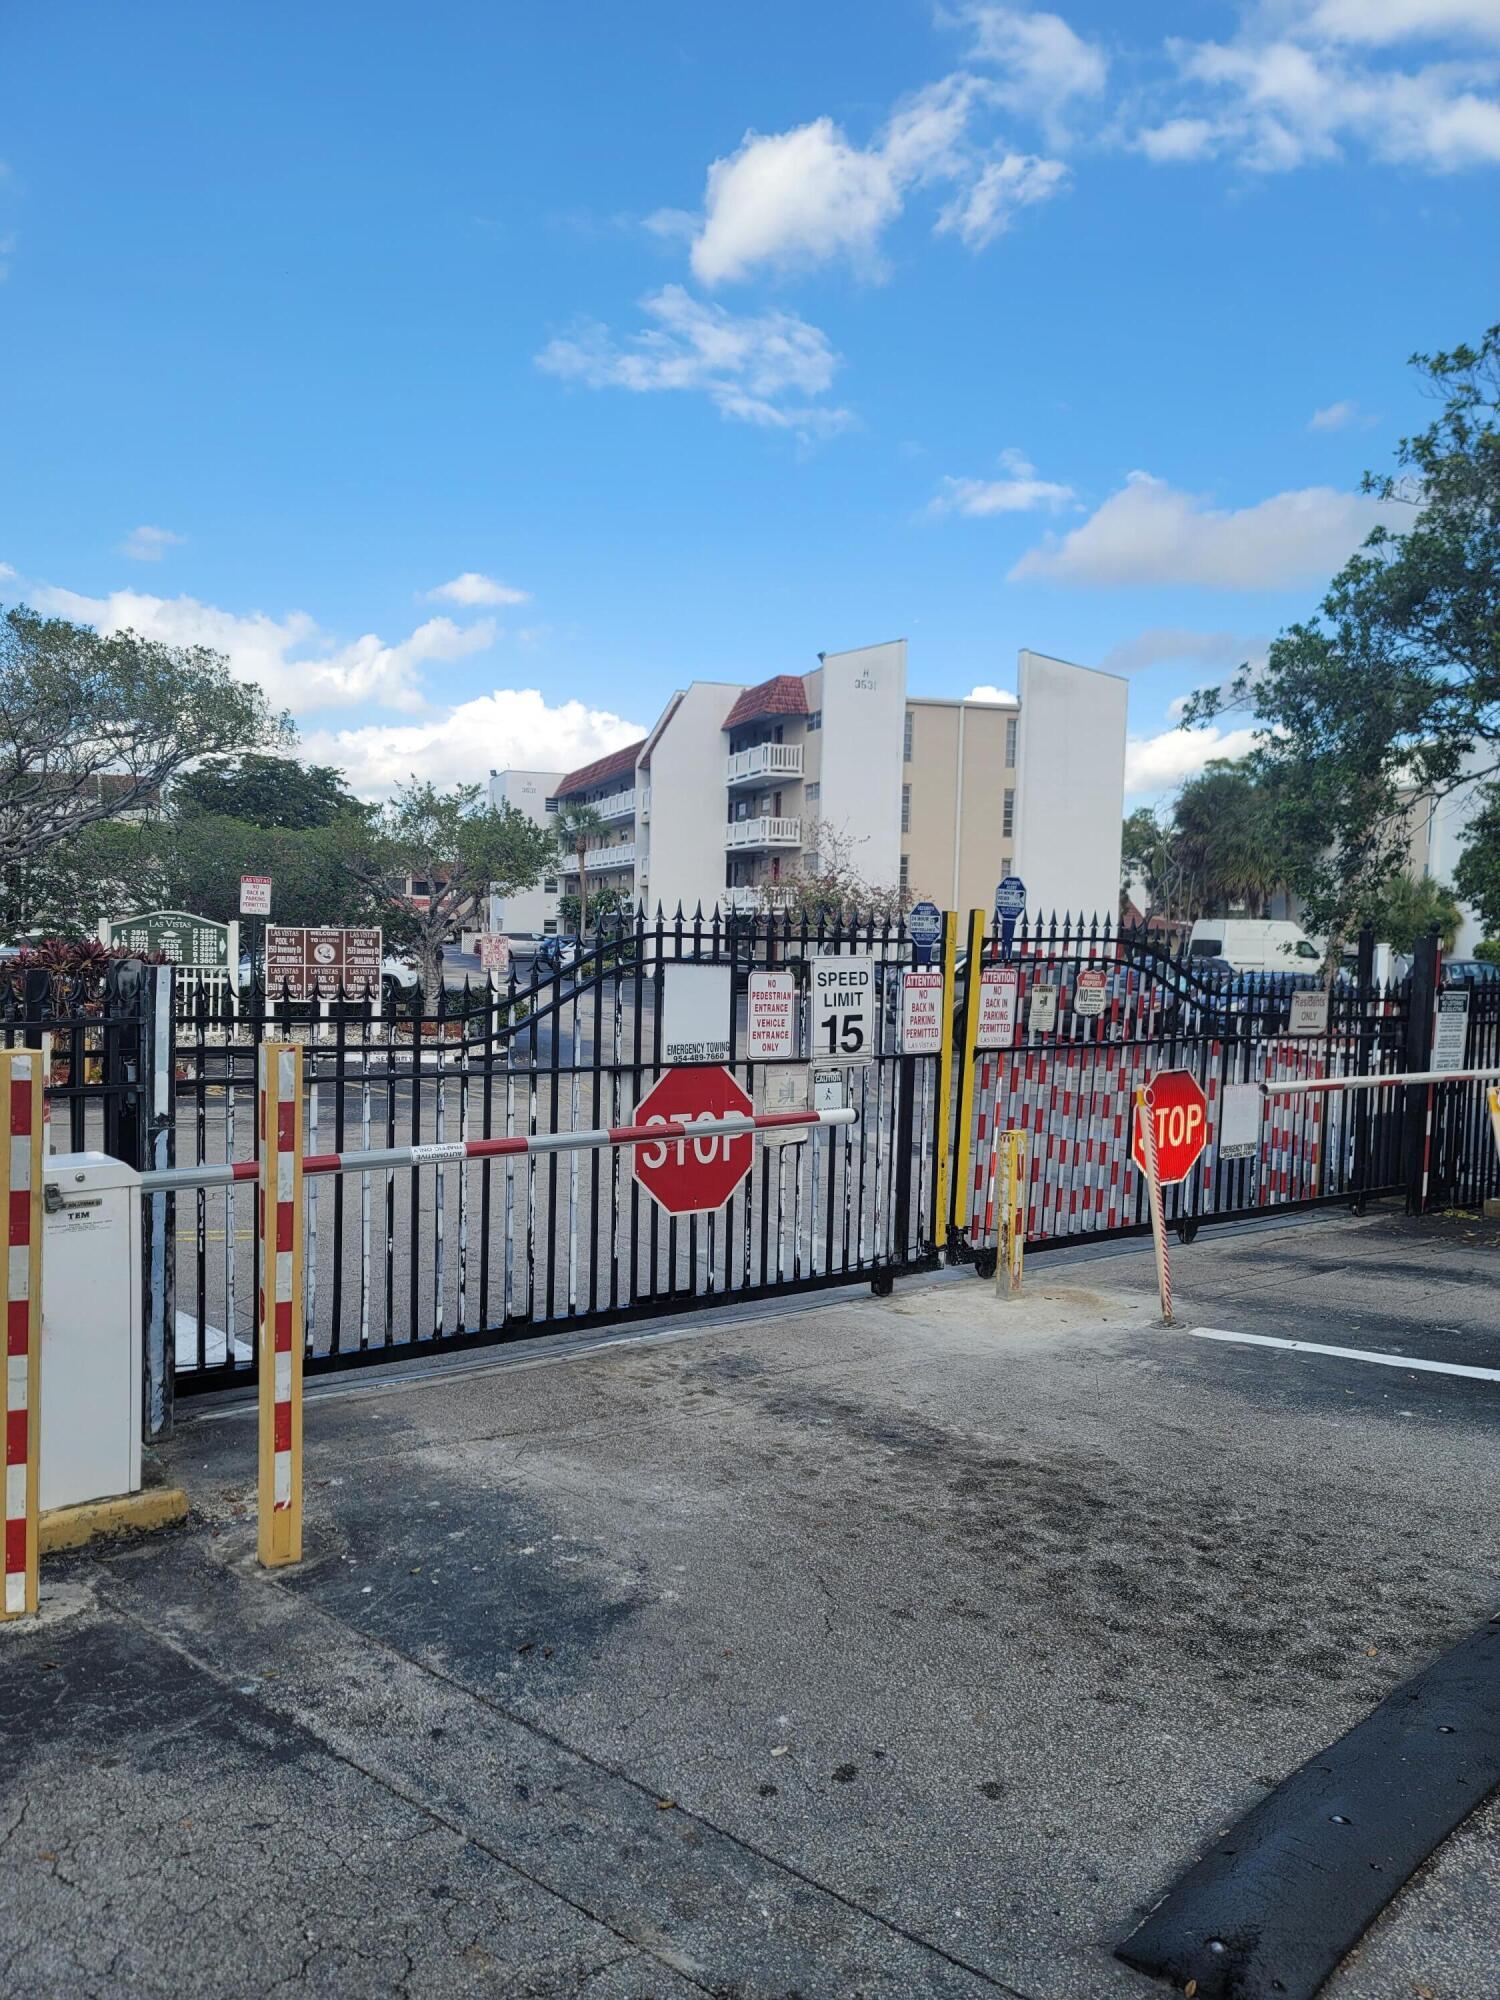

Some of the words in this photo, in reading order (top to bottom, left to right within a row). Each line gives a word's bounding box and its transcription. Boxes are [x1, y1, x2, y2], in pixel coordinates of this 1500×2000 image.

[818, 972, 868, 986] SPEED
[906, 976, 940, 986] ATTENTION
[982, 972, 1015, 982] ATTENTION
[768, 980, 776, 988] NO
[919, 990, 928, 999] NO
[993, 986, 1002, 995] NO
[752, 992, 791, 1000] PEDESTRIAN
[824, 992, 864, 1007] LIMIT
[1079, 989, 1088, 1002] NO
[755, 1004, 788, 1012] ENTRANCE
[912, 1003, 926, 1012] BACK
[929, 1003, 934, 1012] IN
[986, 999, 1000, 1007] BACK
[1002, 999, 1008, 1008] IN
[984, 1011, 1008, 1020] PARKING
[1301, 1012, 1318, 1020] ONLY
[757, 1019, 785, 1027] VEHICLE
[910, 1016, 935, 1025] PARKING
[979, 1024, 1010, 1032] PERMITTED
[752, 1031, 789, 1039] ENTRANCE
[822, 1014, 864, 1053] 15
[906, 1028, 938, 1038] PERMITTED
[667, 1042, 704, 1055] EMERGENCY
[706, 1042, 730, 1052] TOWING
[762, 1043, 779, 1051] ONLY
[673, 1053, 724, 1062] 954-489-7660
[1139, 1104, 1202, 1149] TOP
[643, 1110, 745, 1168] STOP
[1221, 1145, 1241, 1154] EMERGENCY
[1243, 1142, 1257, 1150] TOWING
